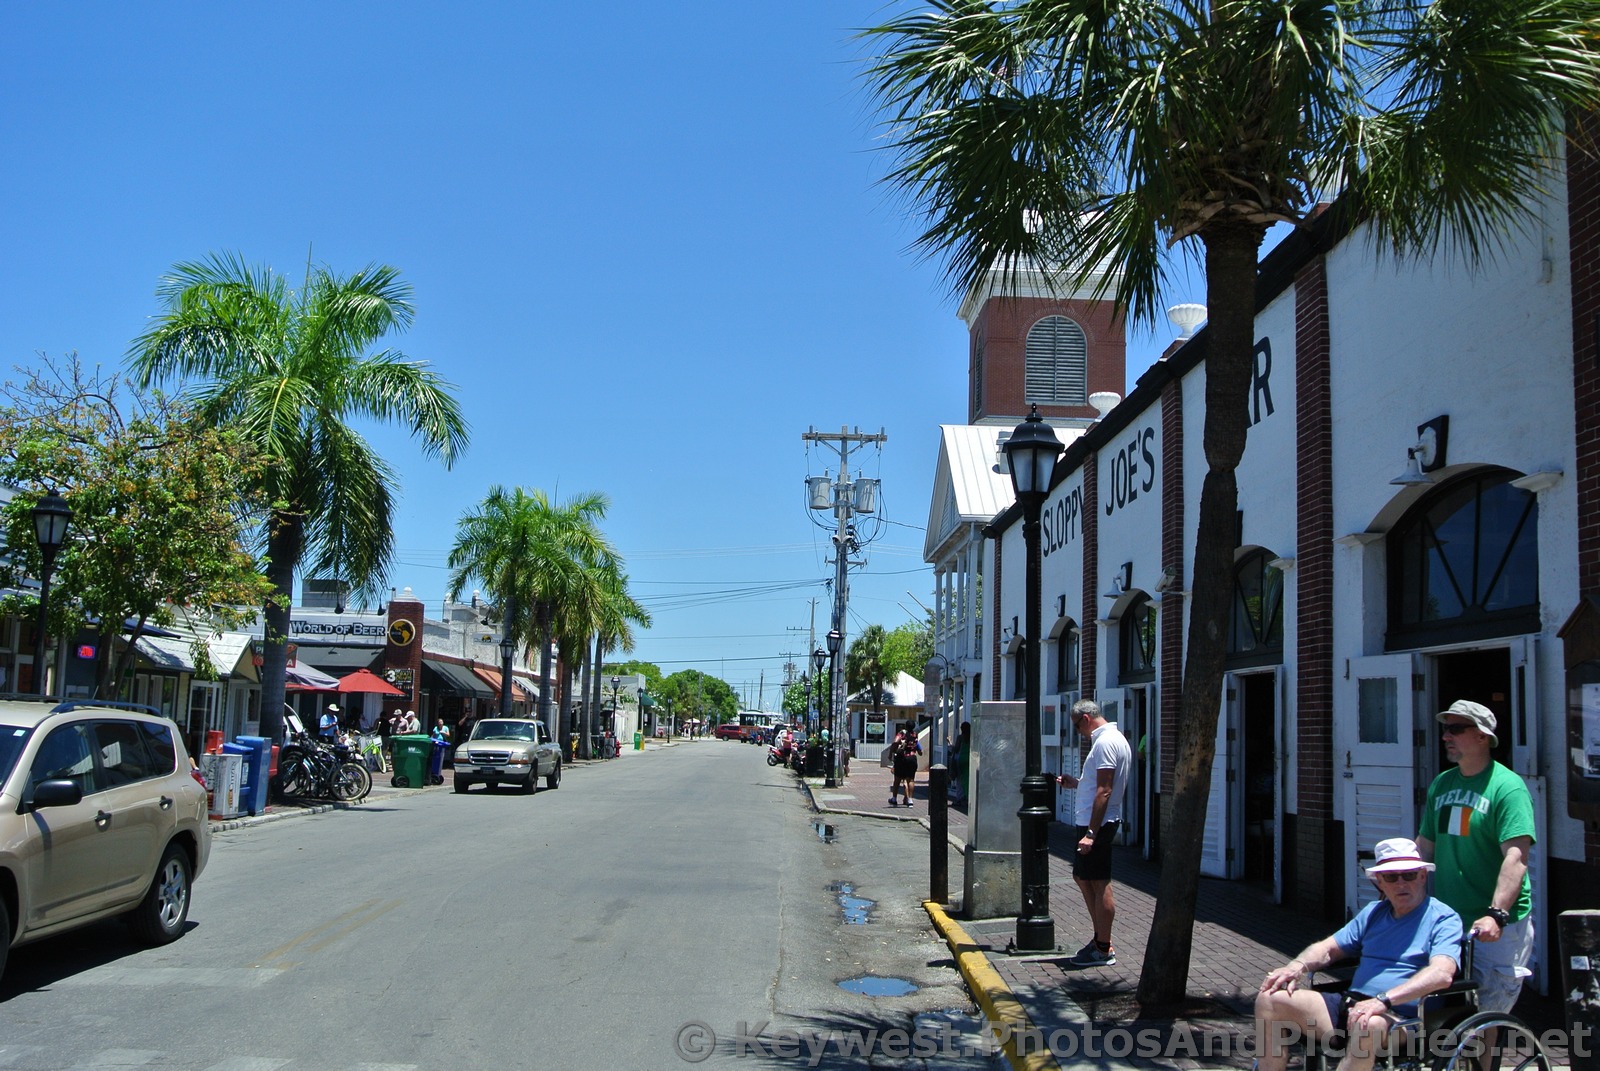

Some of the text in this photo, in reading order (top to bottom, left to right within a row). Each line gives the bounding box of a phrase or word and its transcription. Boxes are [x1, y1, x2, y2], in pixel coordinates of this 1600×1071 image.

[1105, 427, 1155, 516] JOE'S
[290, 621, 385, 636] WORLD OF BEER
[1434, 788, 1490, 815] IRELAND
